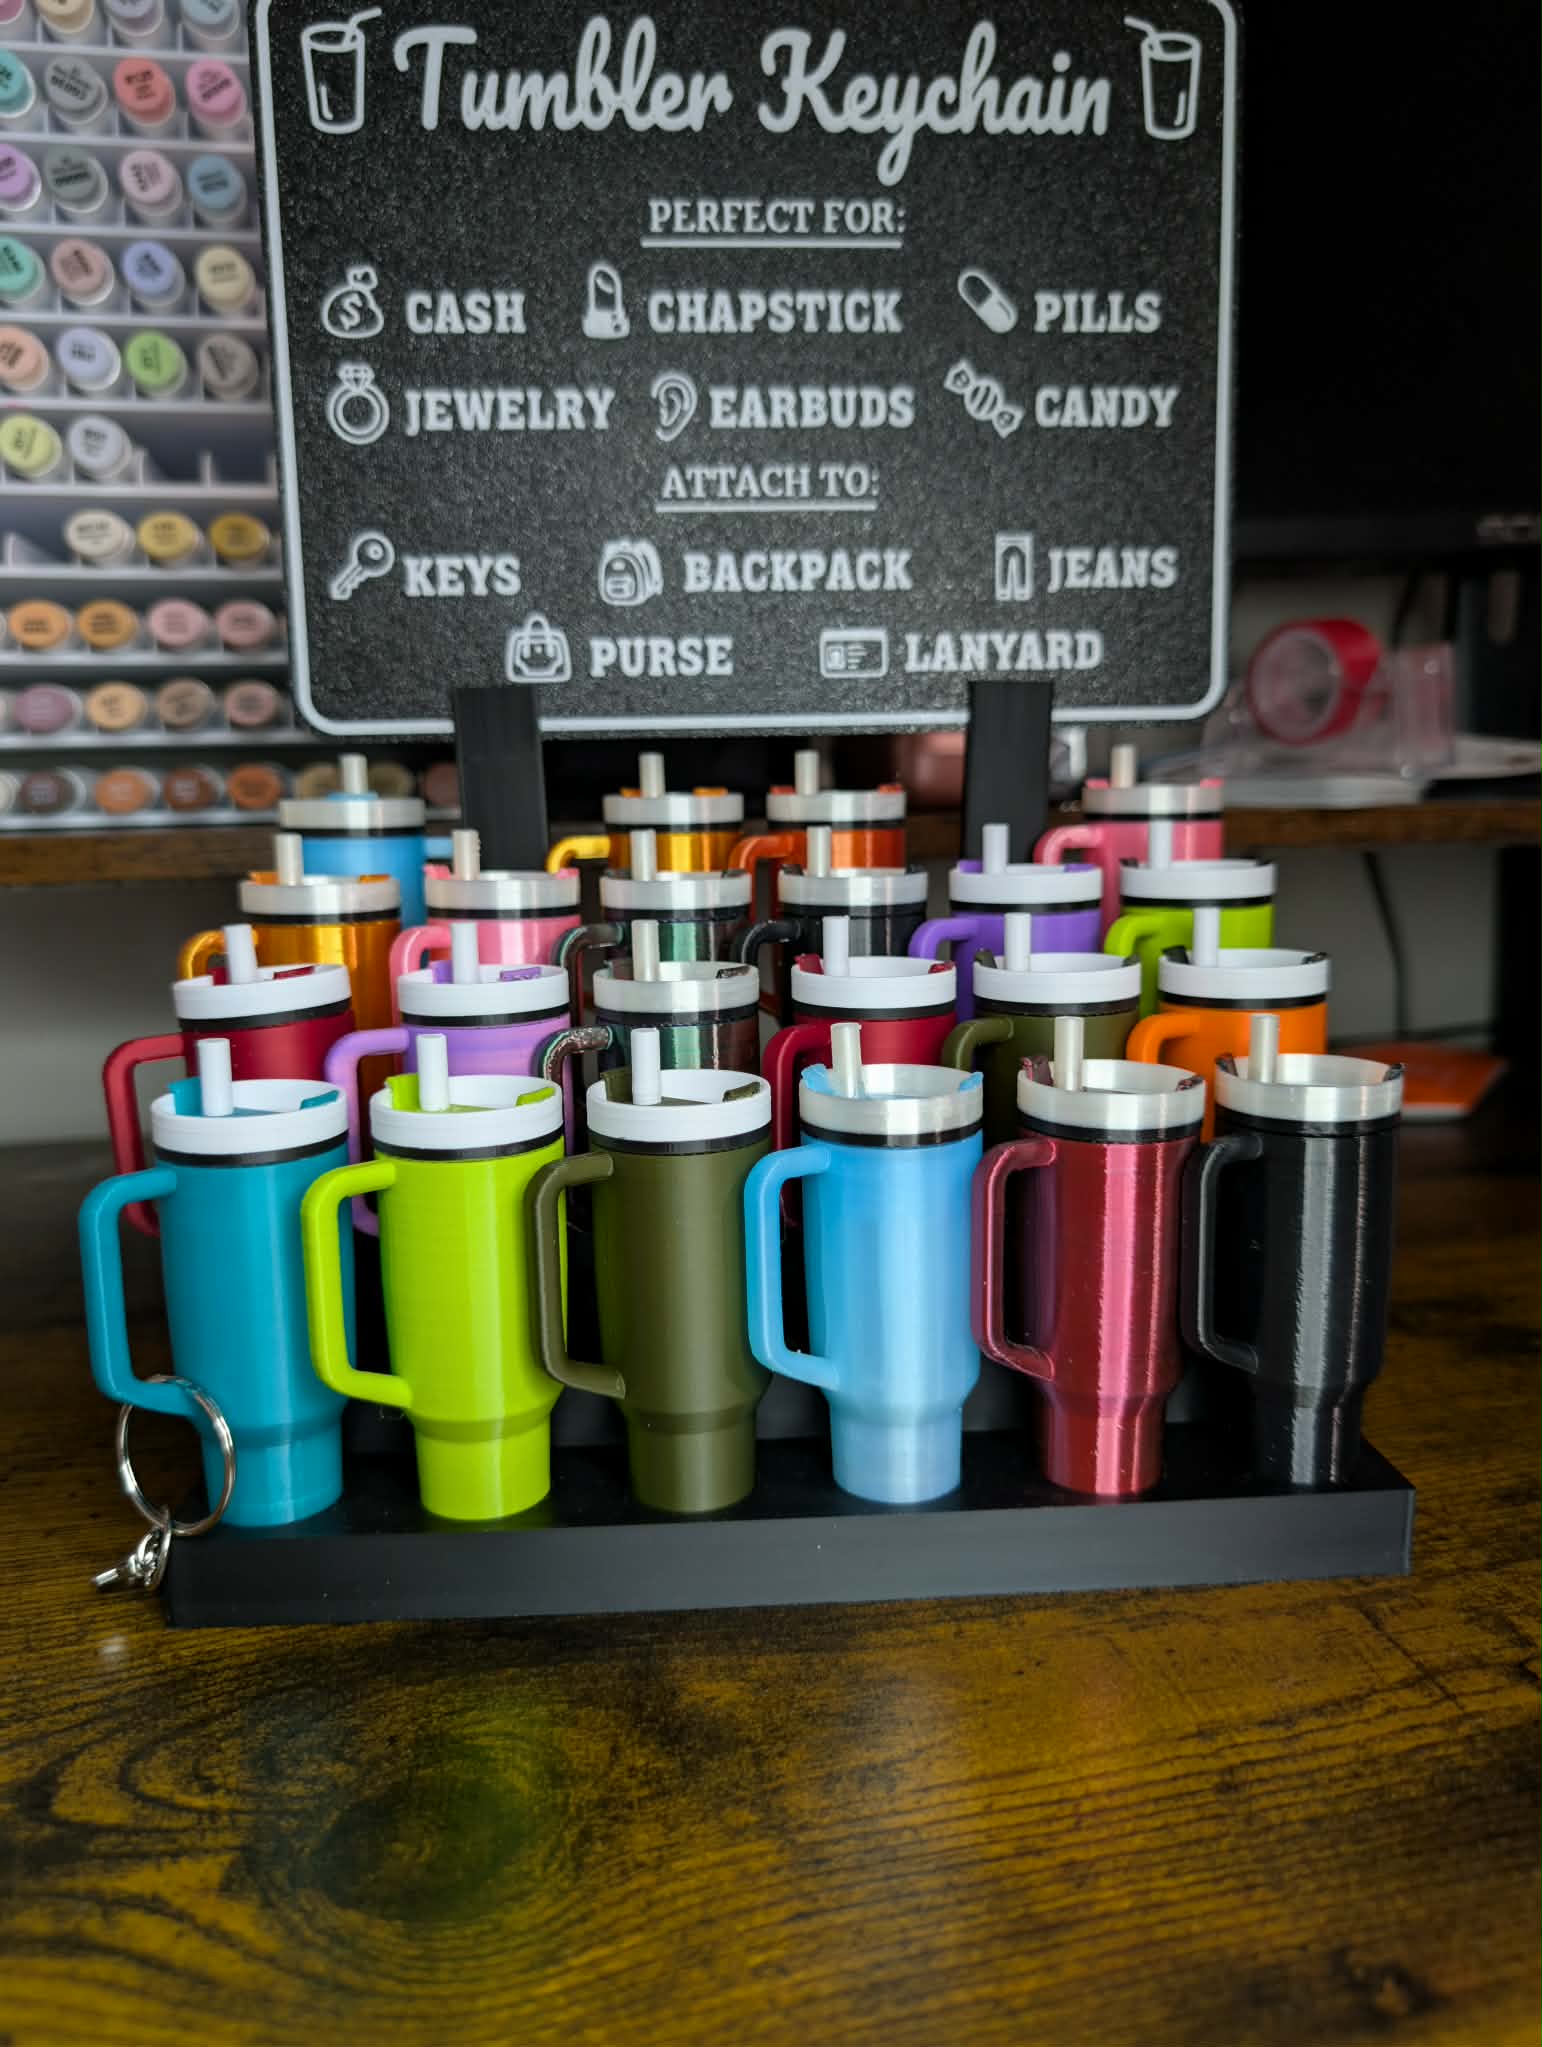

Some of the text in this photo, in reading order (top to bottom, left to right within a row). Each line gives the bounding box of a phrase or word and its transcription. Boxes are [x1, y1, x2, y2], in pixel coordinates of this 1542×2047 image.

[393, 16, 1110, 186] Tumbler Keychain
[649, 199, 905, 234] PERFECT FOR:
[406, 291, 526, 334] CASH
[648, 290, 902, 333] CHAPSTICK
[1034, 292, 1160, 333] PILLS
[404, 385, 616, 437] JEWELRY
[708, 385, 915, 429] EARBUDS
[1035, 387, 1178, 427] CANDY
[661, 462, 880, 498] ATTACH TO:
[402, 553, 522, 597] KEYS
[682, 547, 914, 594] BACKPACK
[1047, 547, 1177, 594] JEANS
[588, 634, 734, 678] PURSE
[904, 630, 1103, 673] LANYARD
